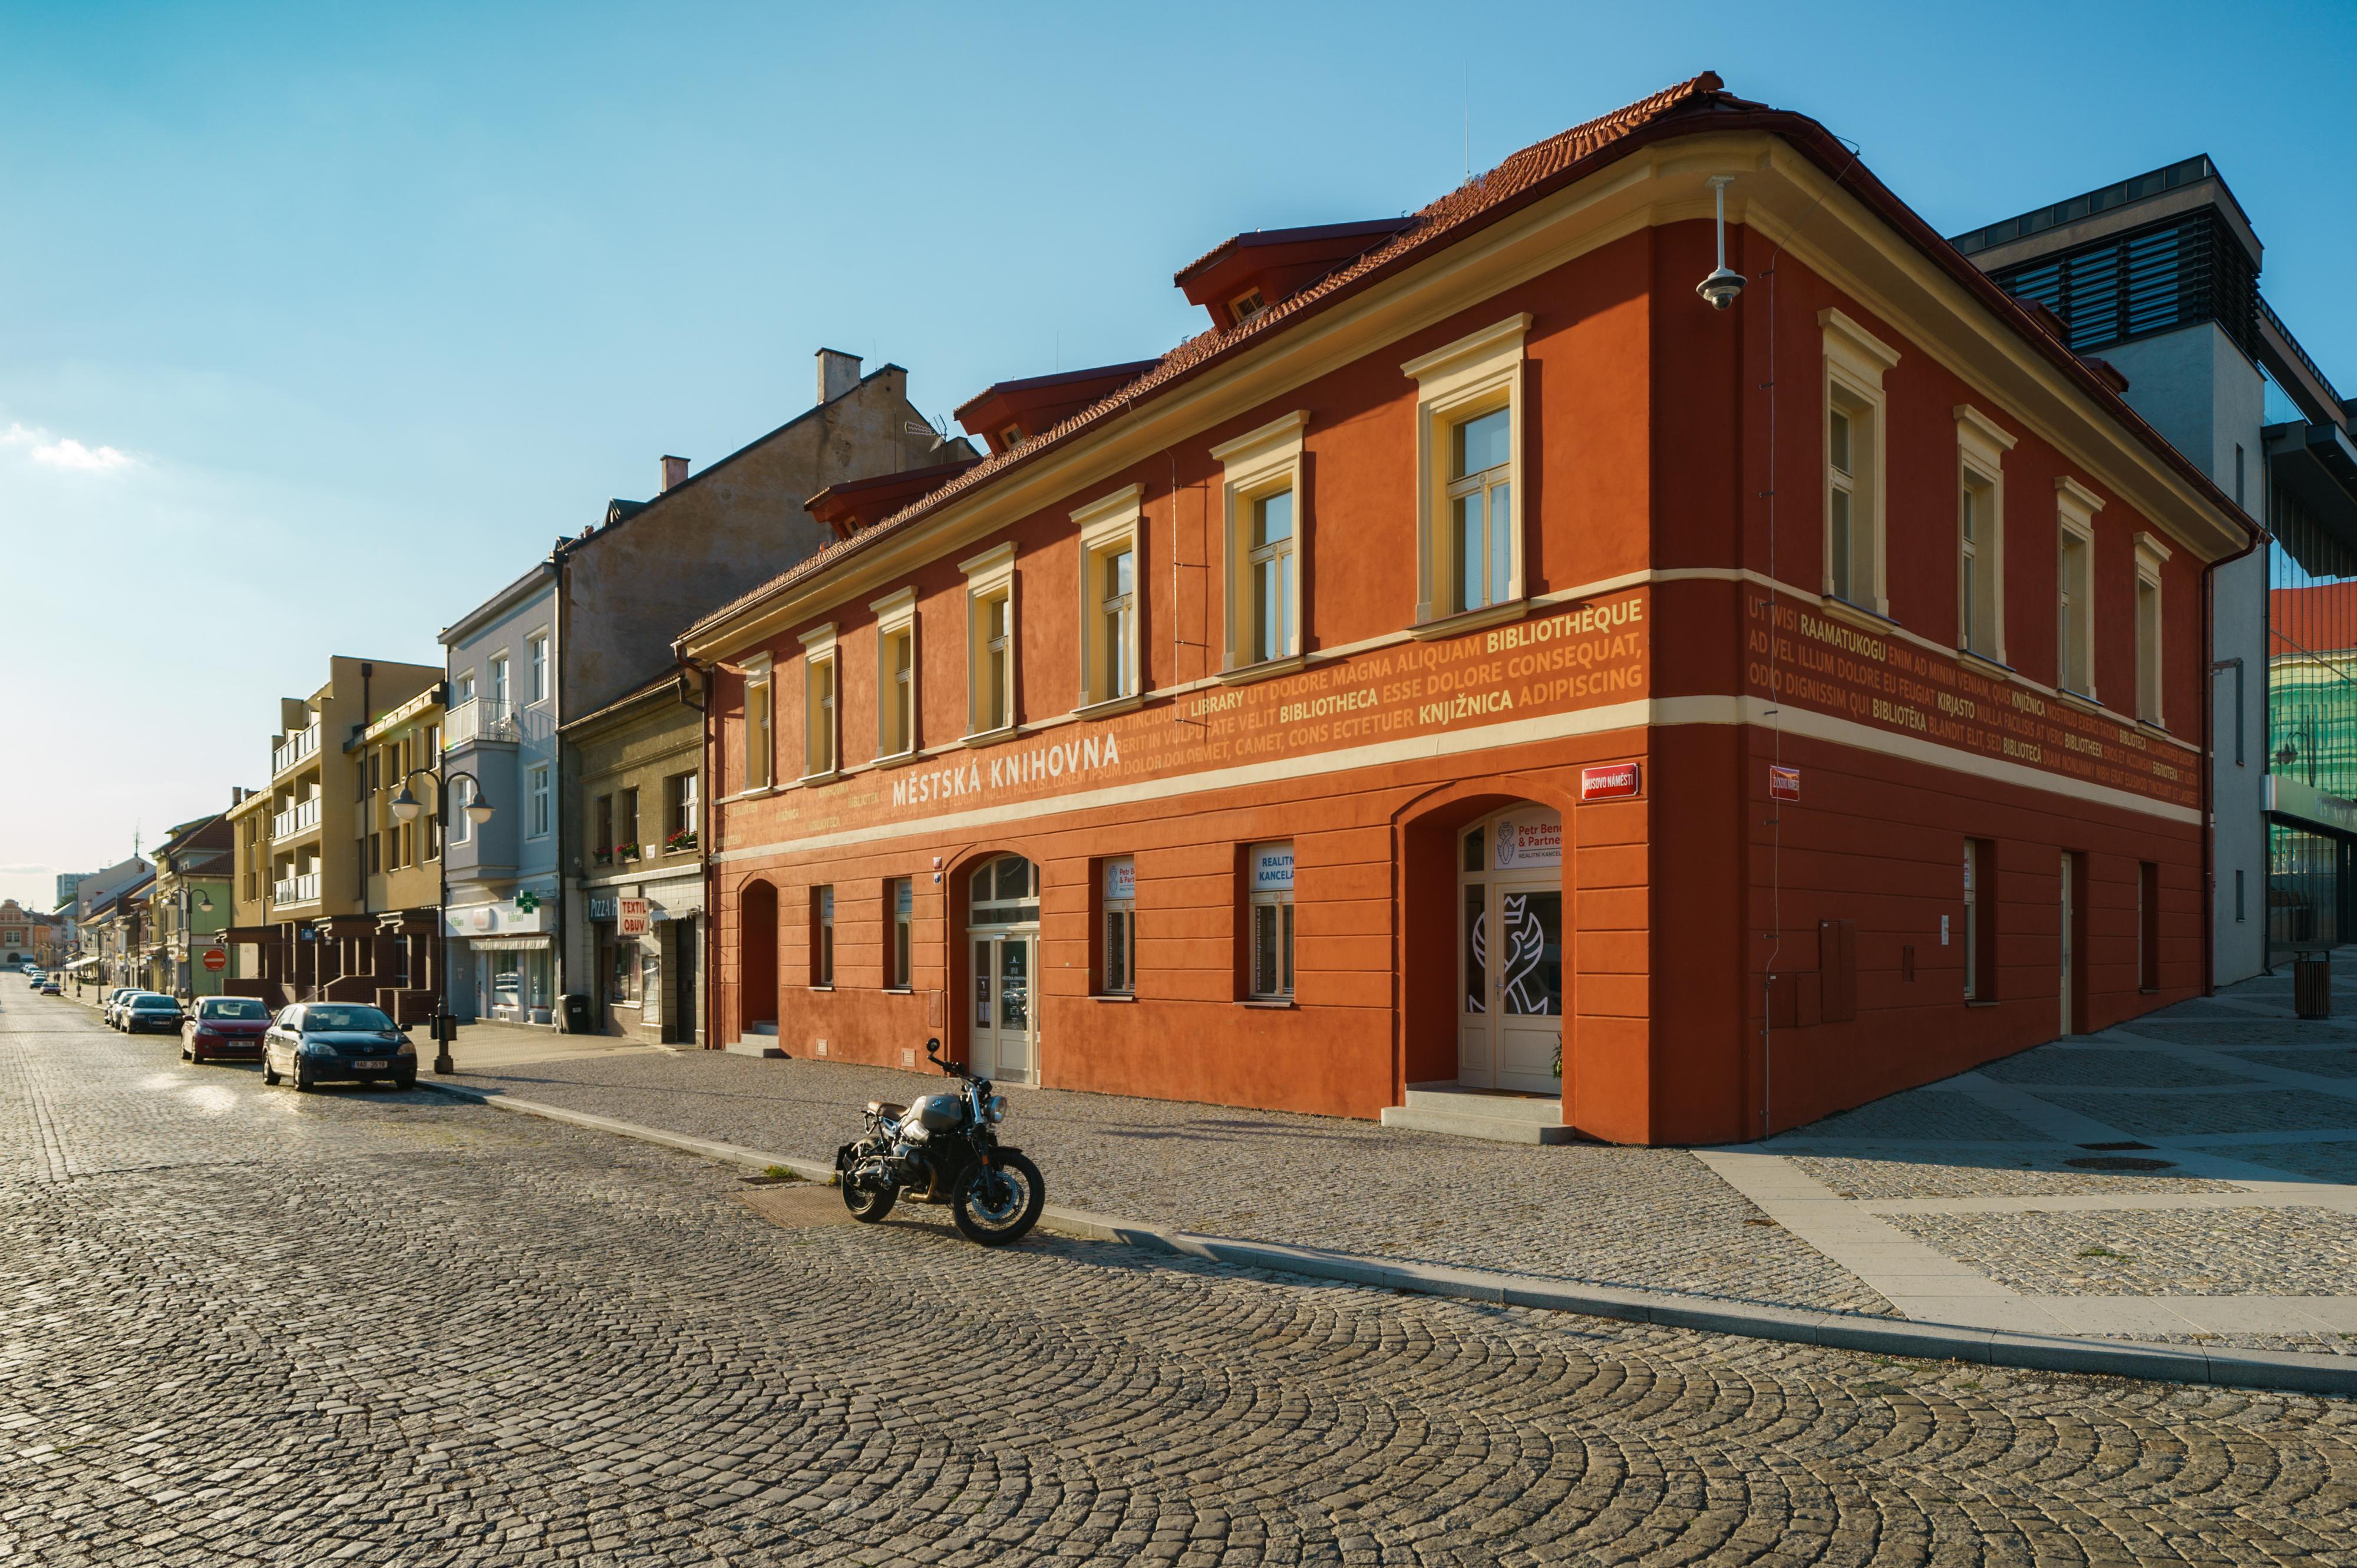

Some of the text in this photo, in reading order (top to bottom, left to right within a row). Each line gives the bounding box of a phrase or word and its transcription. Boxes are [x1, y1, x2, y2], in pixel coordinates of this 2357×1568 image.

[818, 781, 849, 798] KNIHOVNA
[1050, 728, 1072, 747] NIBH
[1075, 718, 1123, 741] EUISMOD
[1127, 703, 1187, 731] TINCIDUNT
[1191, 690, 1244, 717] LIBRARY
[1247, 685, 1266, 705] UT
[1270, 672, 1328, 700] DOLORE
[1332, 656, 1392, 686] MAGNA
[1397, 636, 1481, 672] ALIQUAM
[1487, 599, 1642, 653] BIBLIOTHÈQUE
[1749, 595, 1767, 622] UT
[1771, 603, 1797, 632] WISI
[1801, 614, 1885, 662] RAAMATUKOGU
[1889, 646, 1912, 671] ENIM
[1914, 655, 1926, 676] AD
[1929, 661, 1956, 687] MINIM
[1957, 672, 1990, 701] VENIAM,
[1993, 682, 2010, 705] QUIS
[2012, 691, 2045, 717] KNJIŽNICA
[2047, 704, 2077, 727] NOSTRUD
[2120, 729, 2146, 751] BIBLIOTECA
[1749, 629, 1767, 655] AD
[1773, 636, 1794, 663] VEL
[1798, 645, 1834, 676] ILLUM
[1838, 658, 1880, 689] DOLORE
[1884, 673, 1896, 694] EU
[1899, 678, 1935, 708] FEUGIAT
[1937, 691, 1975, 719] KIRJASTO
[1977, 704, 2002, 728] NULLA
[2004, 713, 2034, 737] FACILISIS
[2036, 724, 2044, 741] AT
[2046, 727, 2064, 747] VERO
[2065, 732, 2102, 758] BIBLIOTHEEK
[2104, 745, 2117, 762] EROS
[2119, 750, 2125, 765] ET
[808, 816, 840, 831] BIBLIOTECA
[949, 791, 981, 807] FEUGAIT
[983, 786, 1012, 800] NULLA
[1054, 770, 1086, 788] LOREM
[1088, 763, 1121, 781] IPSUM
[1235, 732, 1285, 755] CAMET,
[1289, 725, 1328, 747] CONS
[1333, 708, 1415, 740] ECTETUER
[1419, 689, 1513, 725] KNJIŽNICA
[1518, 665, 1642, 707] ADIPISCING
[849, 791, 879, 808] BIBLIOTEK
[1149, 732, 1160, 748] IN
[1164, 717, 1235, 745] VULPUTATE
[1239, 709, 1276, 731] VELIT
[1280, 688, 1378, 723] BIBLIOTHECA
[1383, 679, 1422, 704] ESSE
[1427, 662, 1502, 695] DOLORE
[1508, 632, 1642, 679] CONSEQUAT,
[1750, 661, 1781, 691] ODIO
[1786, 673, 1846, 709] DIGNISSIM
[1850, 691, 1869, 718] QUI
[1929, 715, 1965, 742] BLANDIT
[1987, 732, 2001, 751] SED
[2044, 749, 2061, 768] DIAM
[2062, 755, 2095, 777] NONUMMY
[2096, 765, 2110, 781] NIBH
[2111, 768, 2124, 785] ERAT
[893, 732, 1120, 807] MĚSTSKÁ KNIHOVNA
[1584, 771, 1633, 790] HUSOVO NÁMĚSTÍ
[1518, 826, 1538, 835] Petr
[1518, 836, 1562, 847] & Partne
[590, 899, 610, 917] PIZZA
[622, 901, 646, 914] TEXTIL
[625, 919, 645, 932] OBUV
